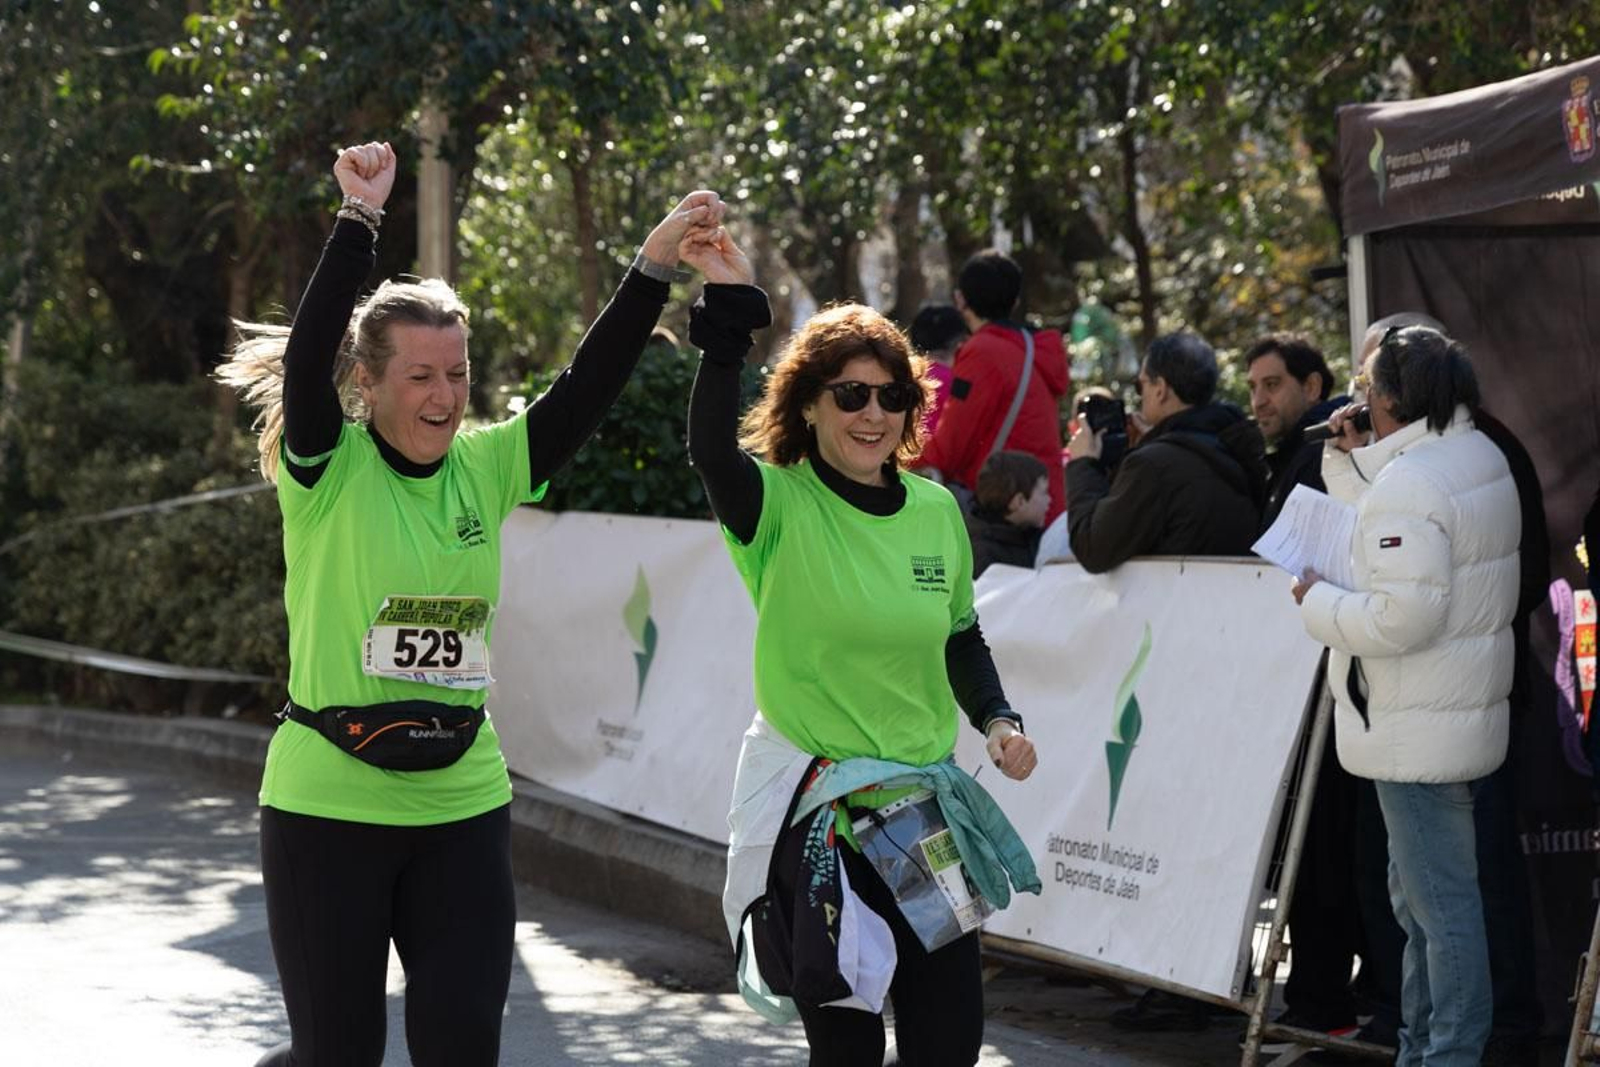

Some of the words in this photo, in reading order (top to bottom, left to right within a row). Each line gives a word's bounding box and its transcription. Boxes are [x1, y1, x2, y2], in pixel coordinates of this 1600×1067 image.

[394, 629, 462, 668] 529
[1046, 834, 1099, 861] atronato
[1100, 842, 1146, 873] Municipal
[1146, 852, 1160, 875] de
[1055, 861, 1102, 892] Deportes
[1103, 874, 1117, 895] de
